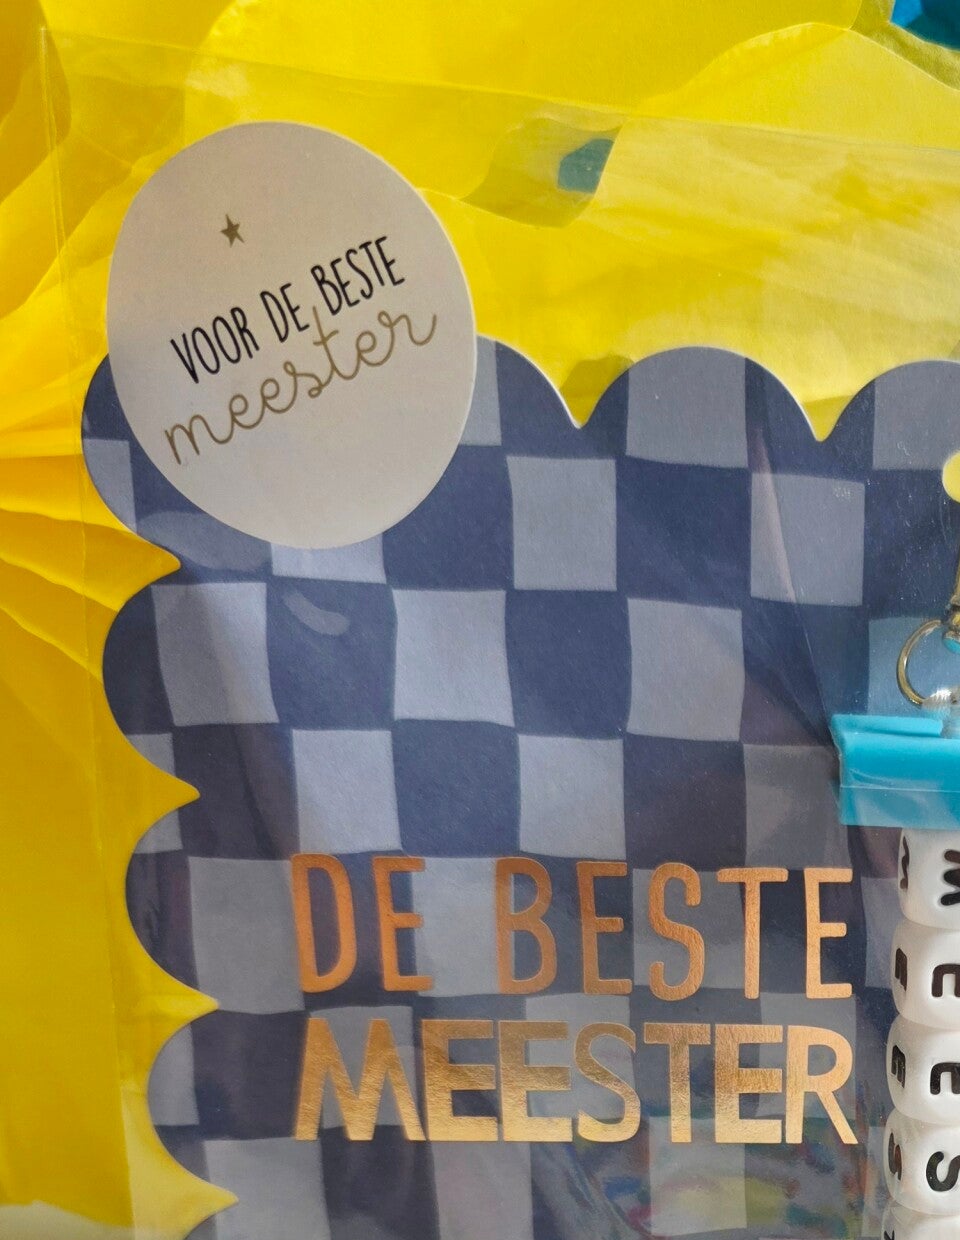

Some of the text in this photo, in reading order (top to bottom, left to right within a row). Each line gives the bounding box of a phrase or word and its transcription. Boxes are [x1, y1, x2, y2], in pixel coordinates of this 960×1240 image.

[169, 236, 405, 384] VOOR DE BESTE
[164, 306, 437, 465] meester
[290, 853, 853, 1000] DE BESTE
[295, 1018, 856, 1145] MEESTER
